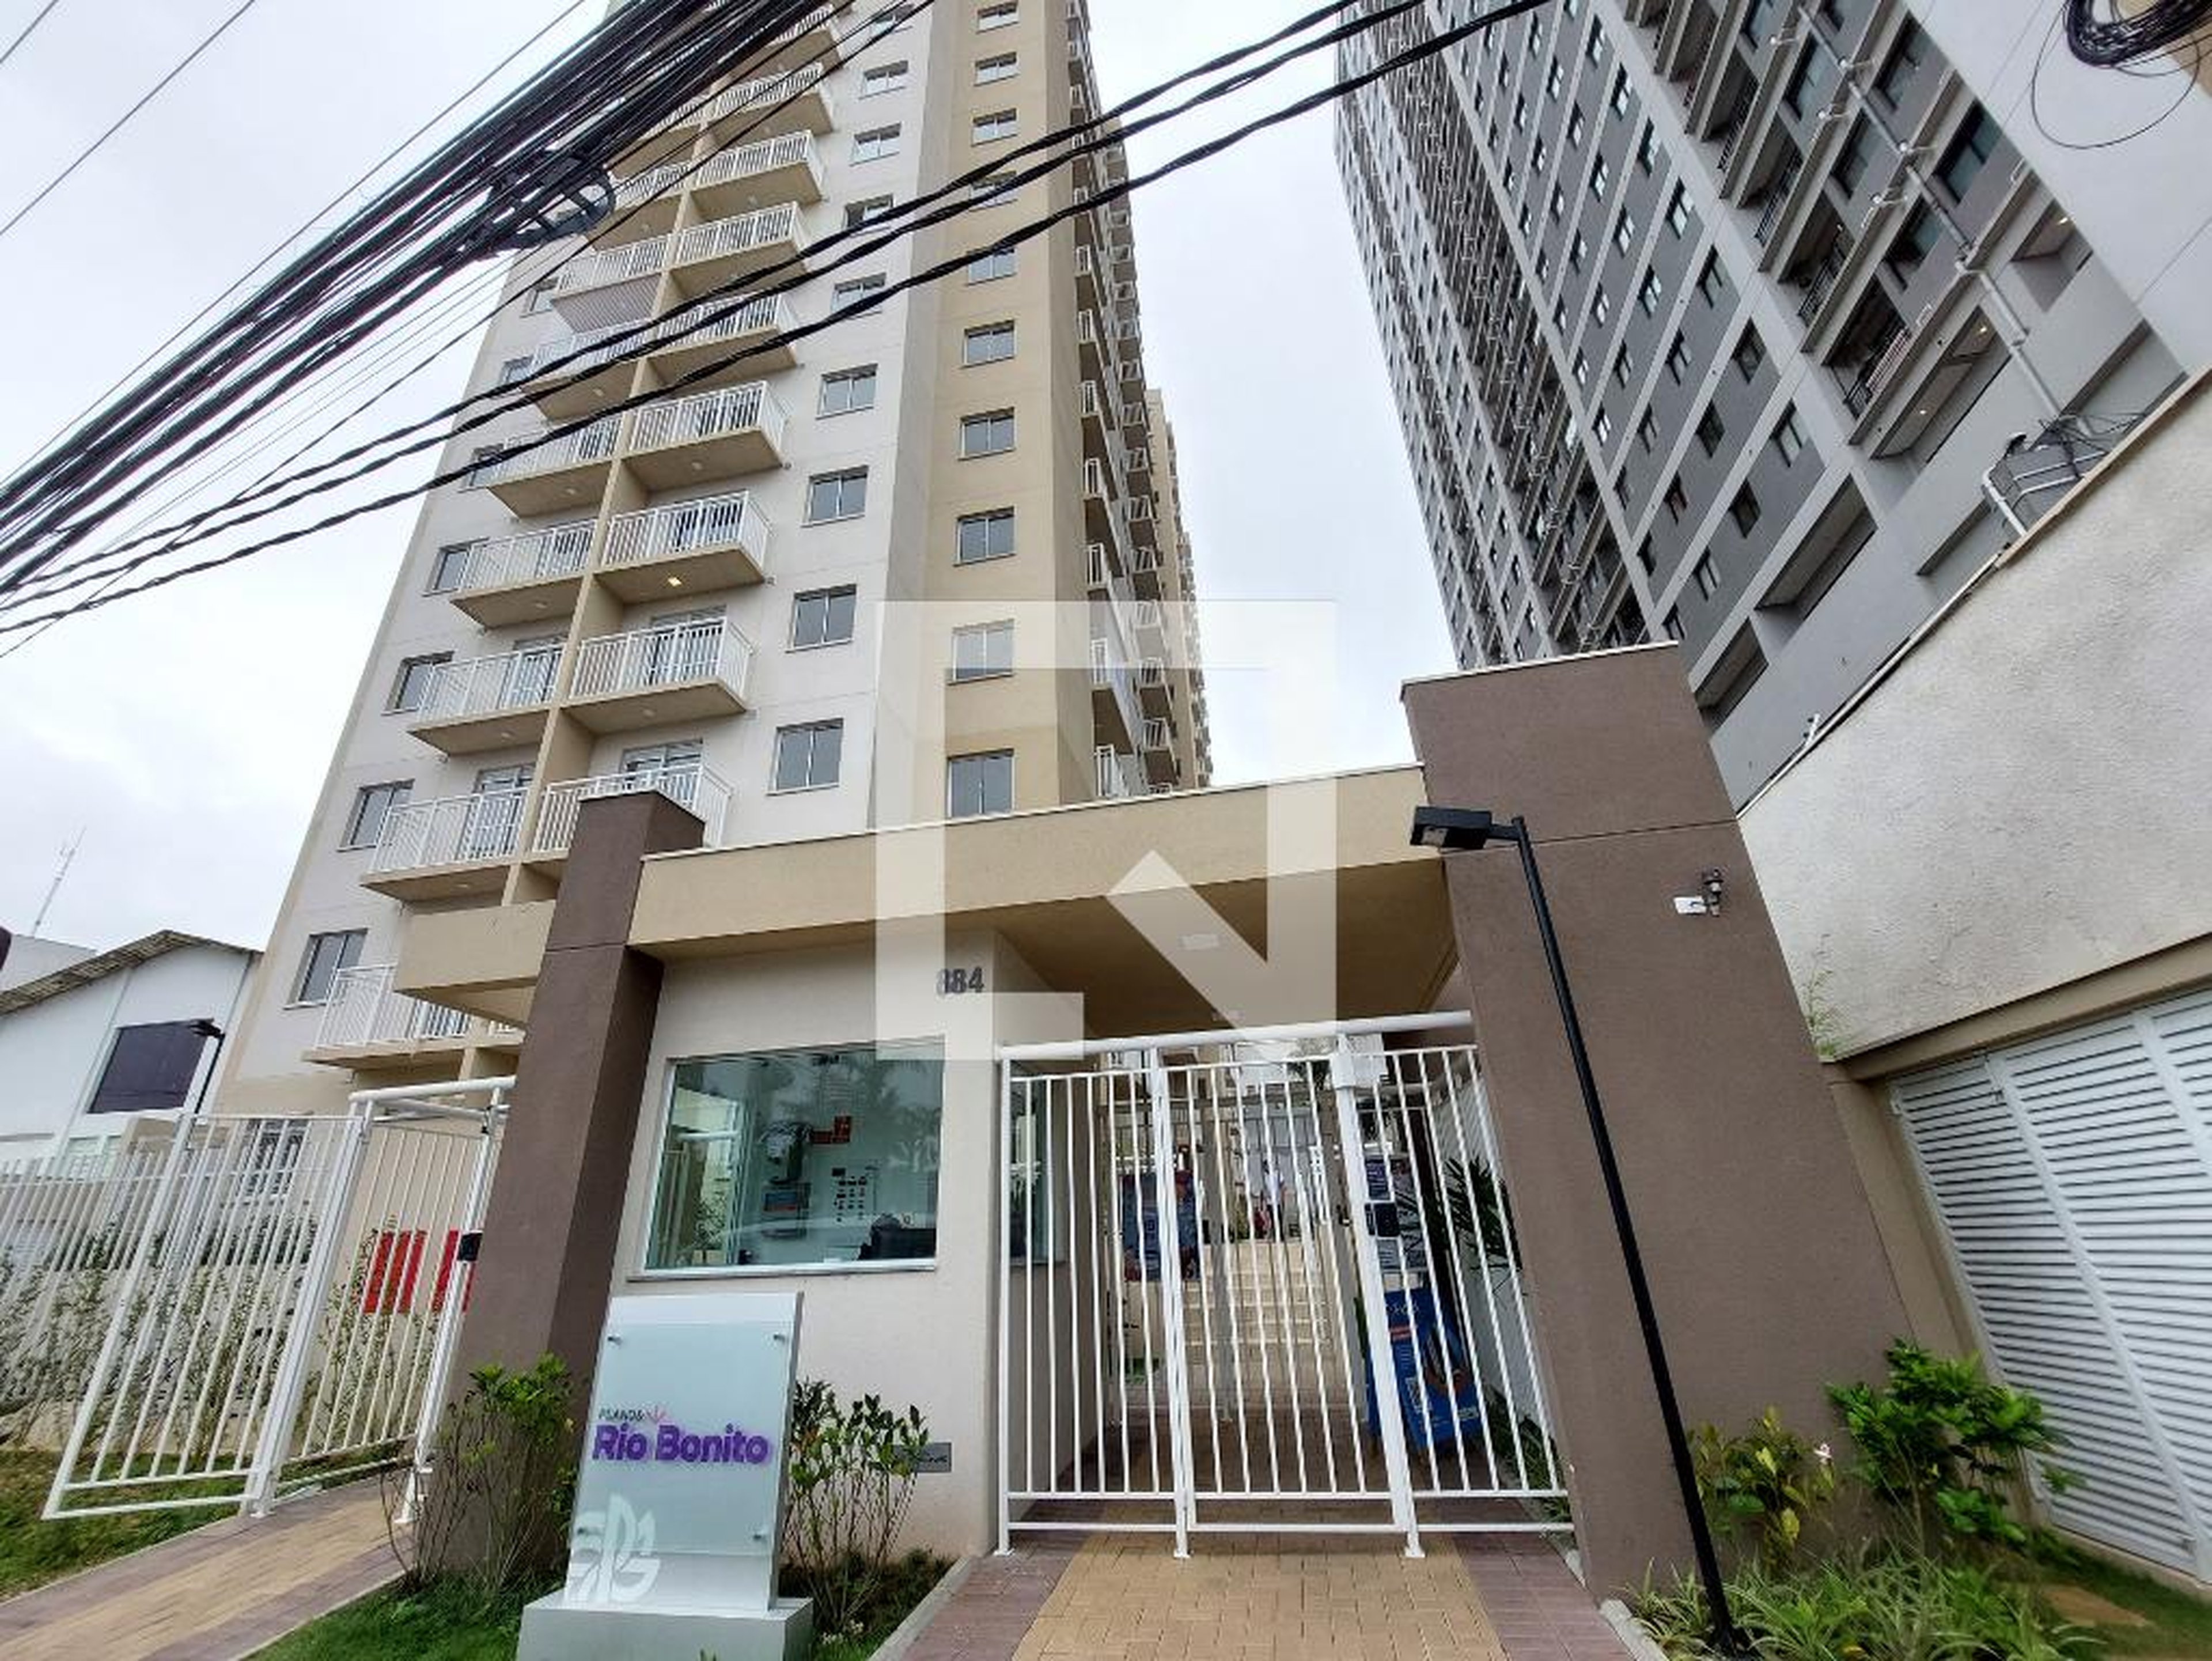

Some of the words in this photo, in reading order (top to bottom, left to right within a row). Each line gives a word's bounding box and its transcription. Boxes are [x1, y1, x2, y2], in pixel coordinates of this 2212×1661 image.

[935, 967, 984, 995] 884
[592, 1422, 647, 1461] Rio
[654, 1423, 768, 1464] Bonito
